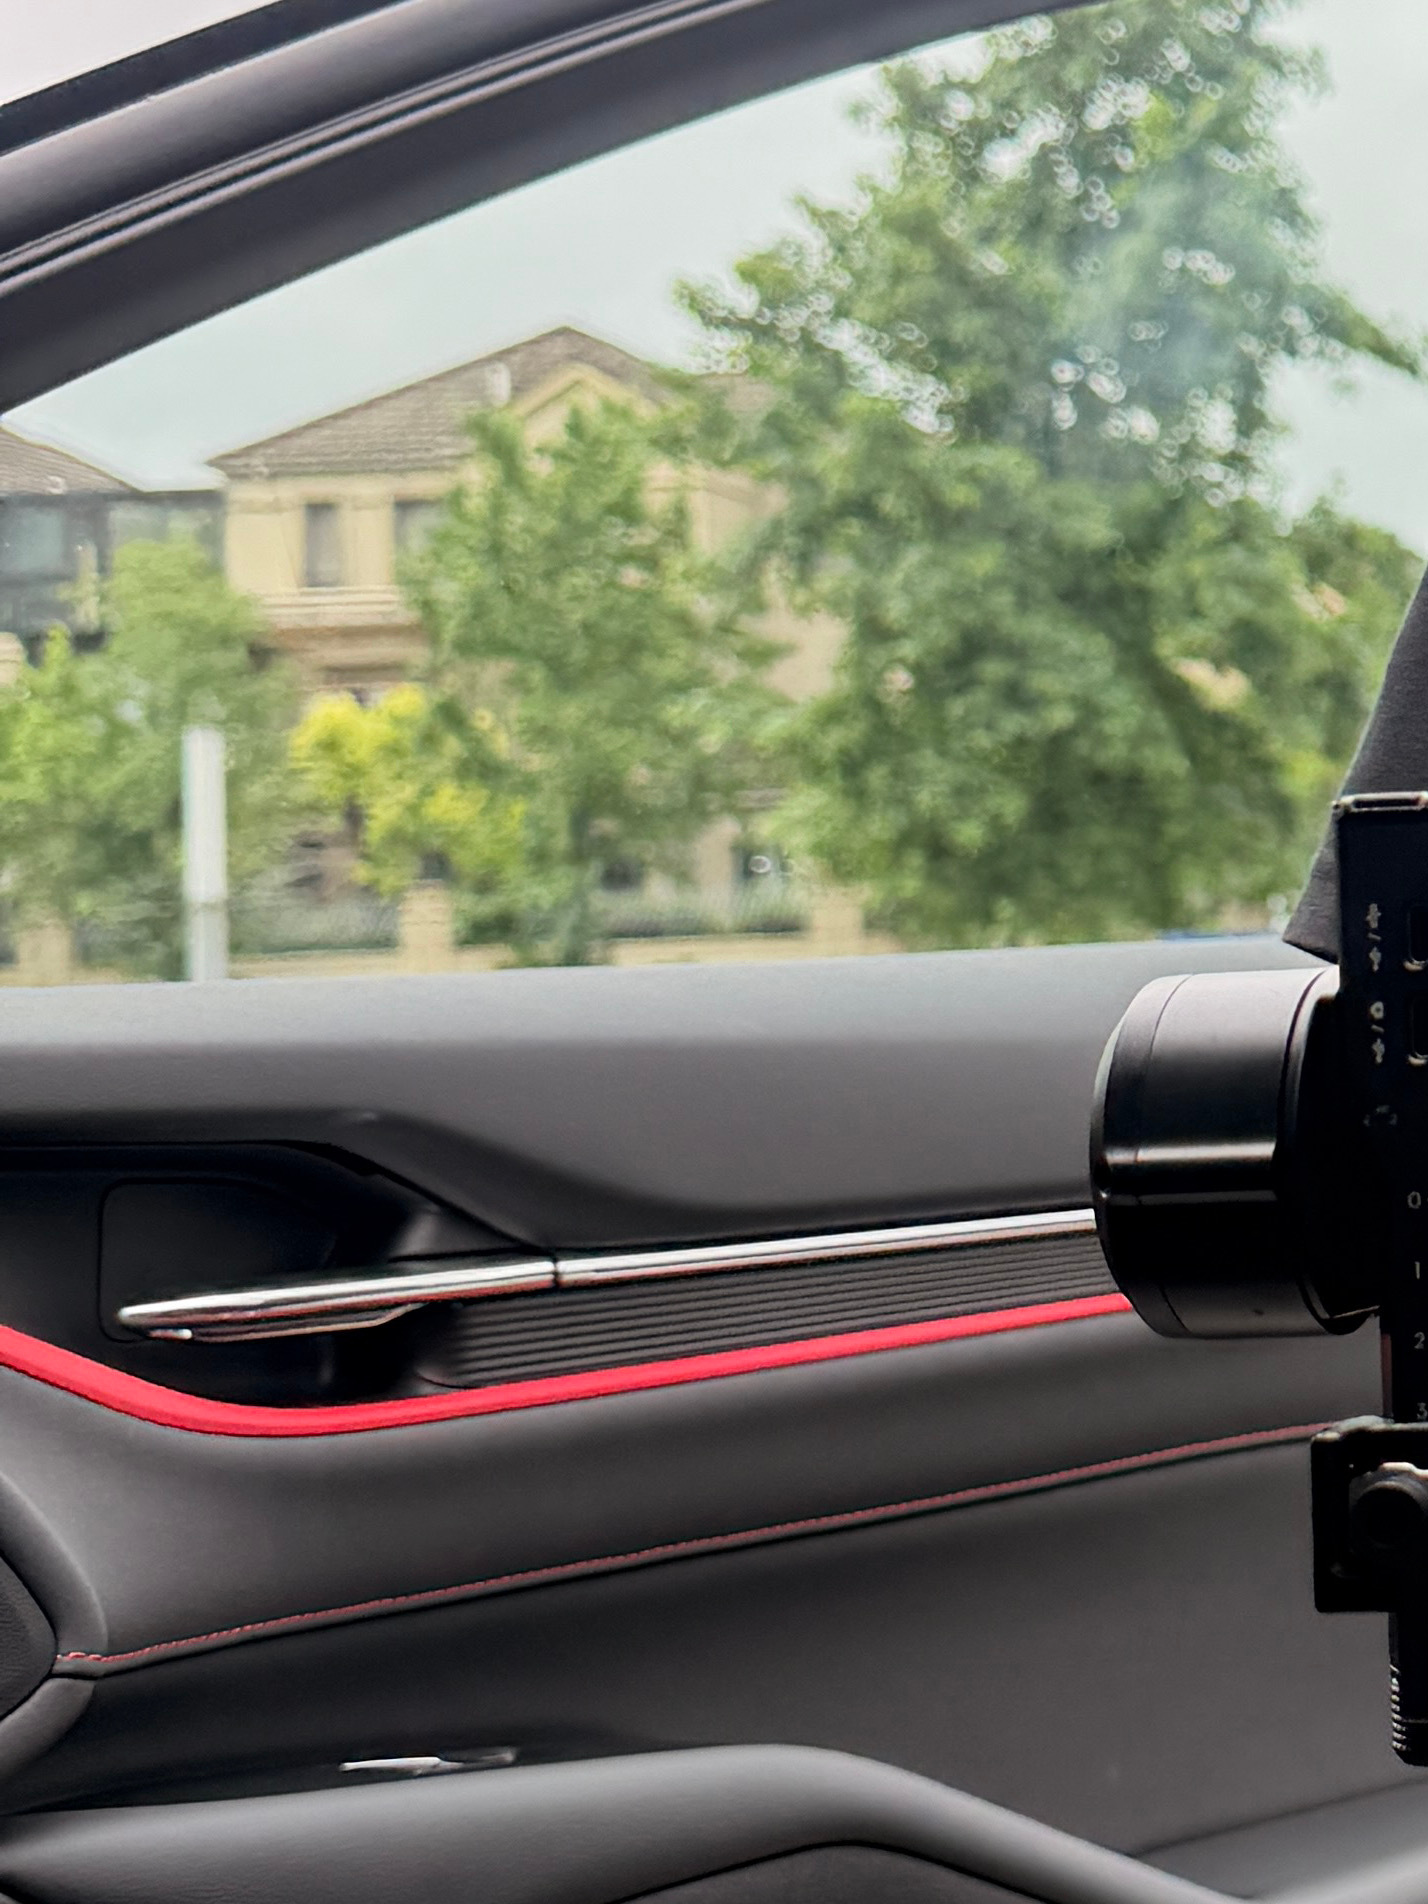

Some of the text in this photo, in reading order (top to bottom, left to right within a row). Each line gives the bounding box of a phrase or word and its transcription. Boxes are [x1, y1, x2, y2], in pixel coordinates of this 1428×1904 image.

[1407, 1191, 1422, 1209] 0
[1414, 1261, 1421, 1280] 1
[1414, 1331, 1426, 1350] 2
